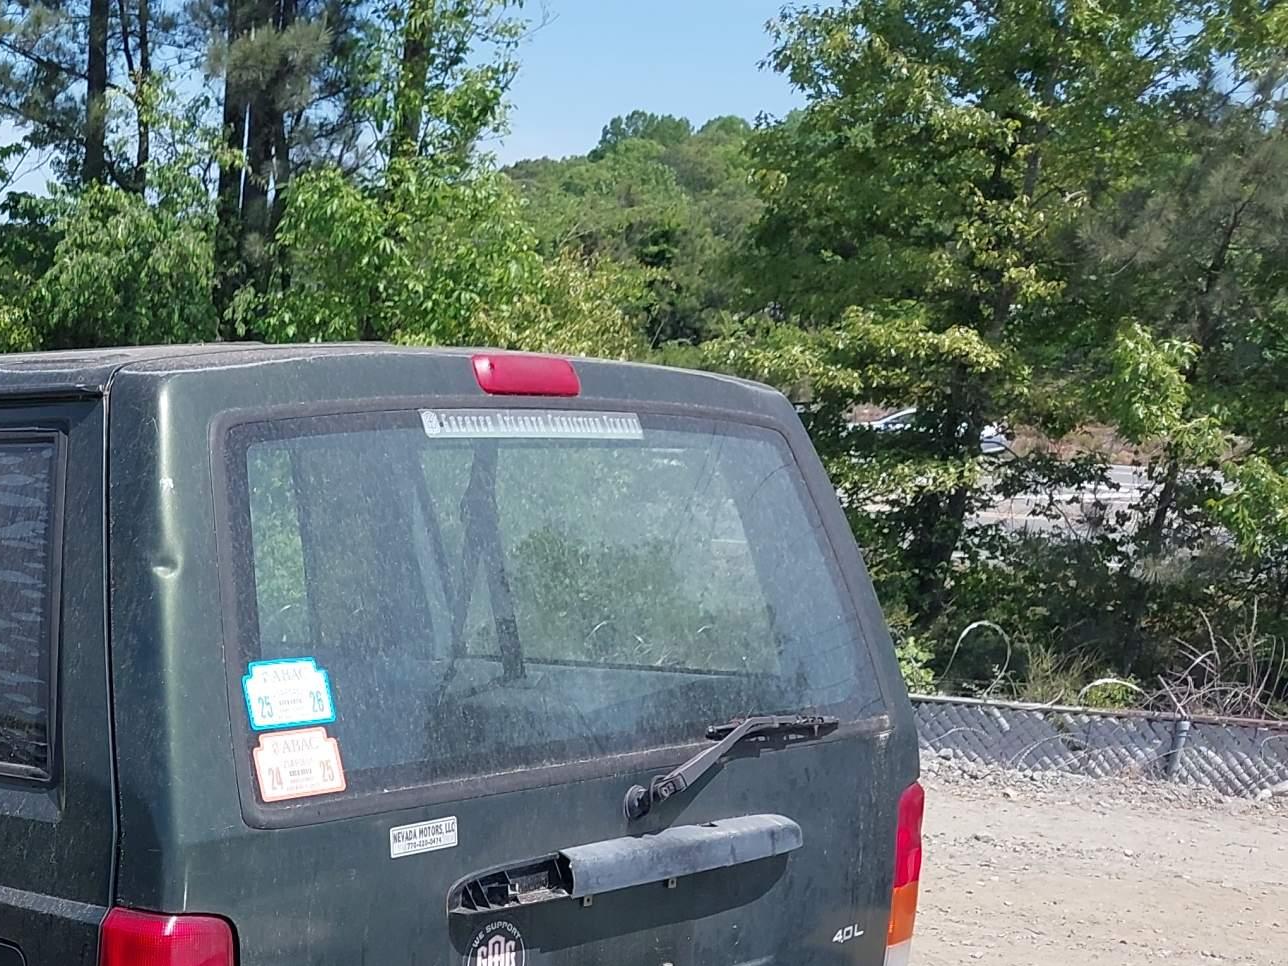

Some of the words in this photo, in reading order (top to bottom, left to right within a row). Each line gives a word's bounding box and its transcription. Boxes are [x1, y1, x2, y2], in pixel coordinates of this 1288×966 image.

[258, 695, 274, 719] 25
[268, 765, 284, 791] 24
[319, 759, 335, 783] 25
[393, 828, 418, 844] NEVADA
[444, 821, 455, 834] LLC
[472, 930, 485, 948] WE
[485, 920, 521, 940] SUPPORT
